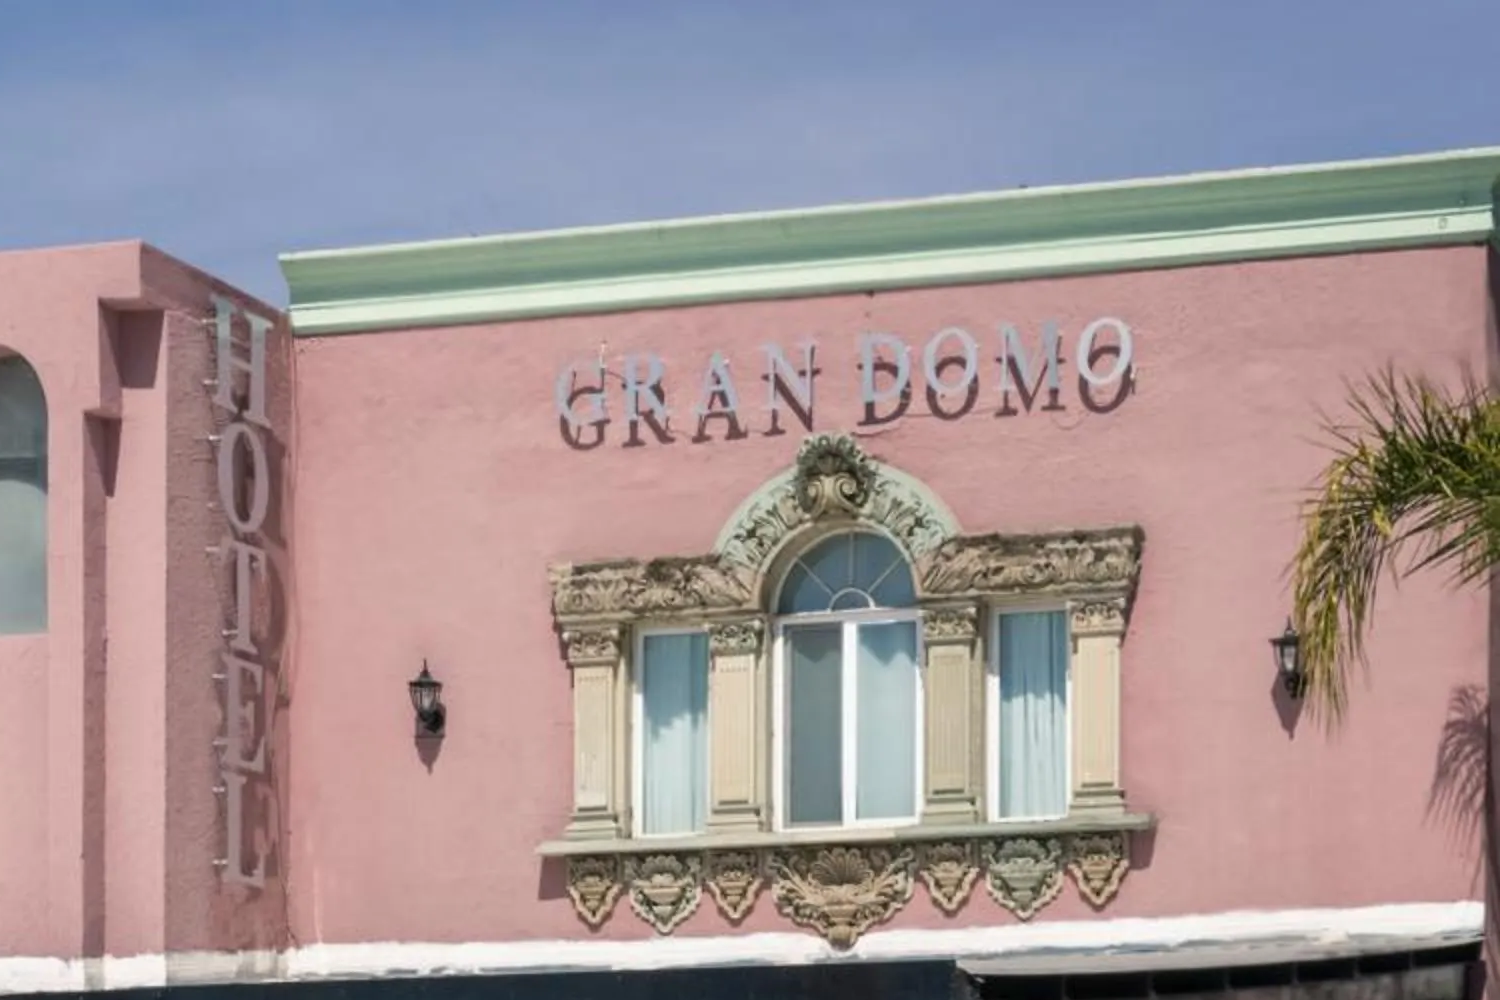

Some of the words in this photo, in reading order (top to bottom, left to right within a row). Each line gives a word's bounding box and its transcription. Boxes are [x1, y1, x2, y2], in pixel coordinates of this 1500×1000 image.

[553, 340, 818, 429] GRAN
[856, 316, 1134, 405] DOMO
[209, 294, 274, 888] HOTEL
